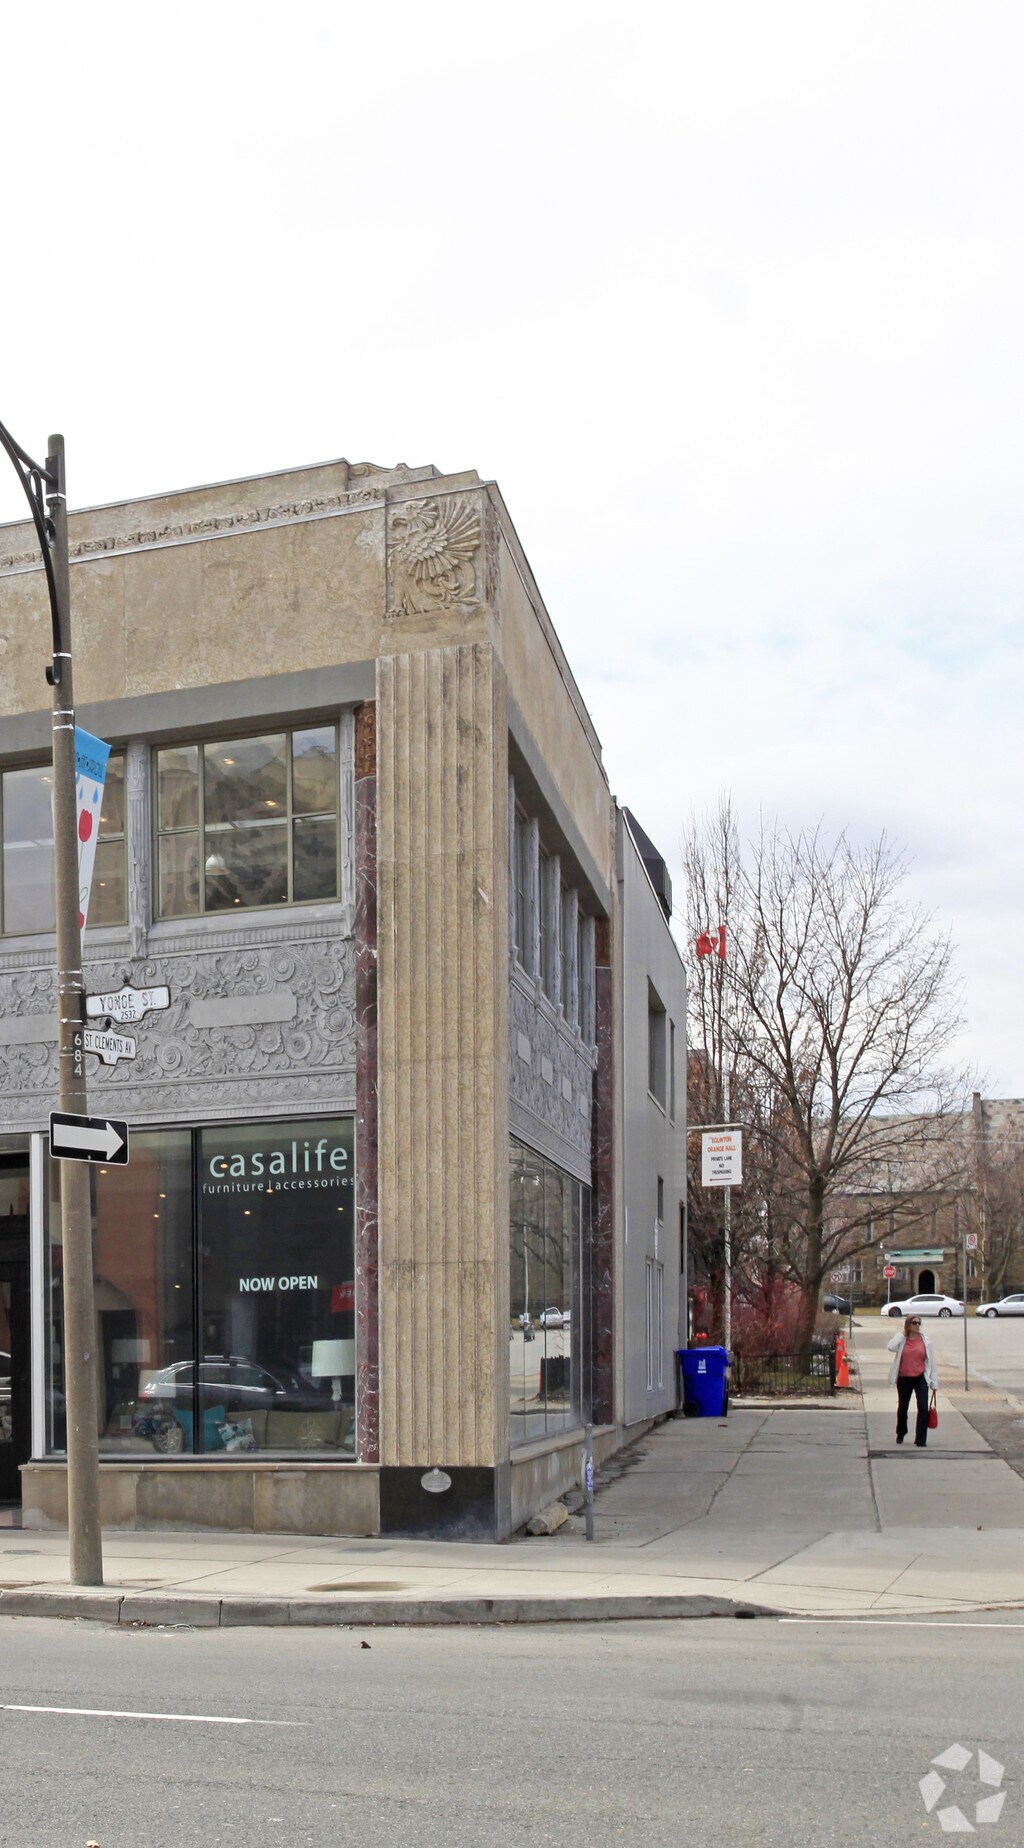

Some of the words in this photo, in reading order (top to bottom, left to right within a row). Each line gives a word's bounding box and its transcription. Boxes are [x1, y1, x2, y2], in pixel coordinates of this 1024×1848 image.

[99, 994, 135, 1012] YONGE
[142, 991, 156, 1006] ST.
[120, 1010, 136, 1020] 2532
[95, 1035, 123, 1052] CLEMENTS
[209, 1139, 348, 1178] casalife
[203, 1183, 264, 1194] furniture
[276, 1176, 355, 1190] accessories
[239, 1277, 275, 1292] NOW
[278, 1276, 318, 1290] OPEN
